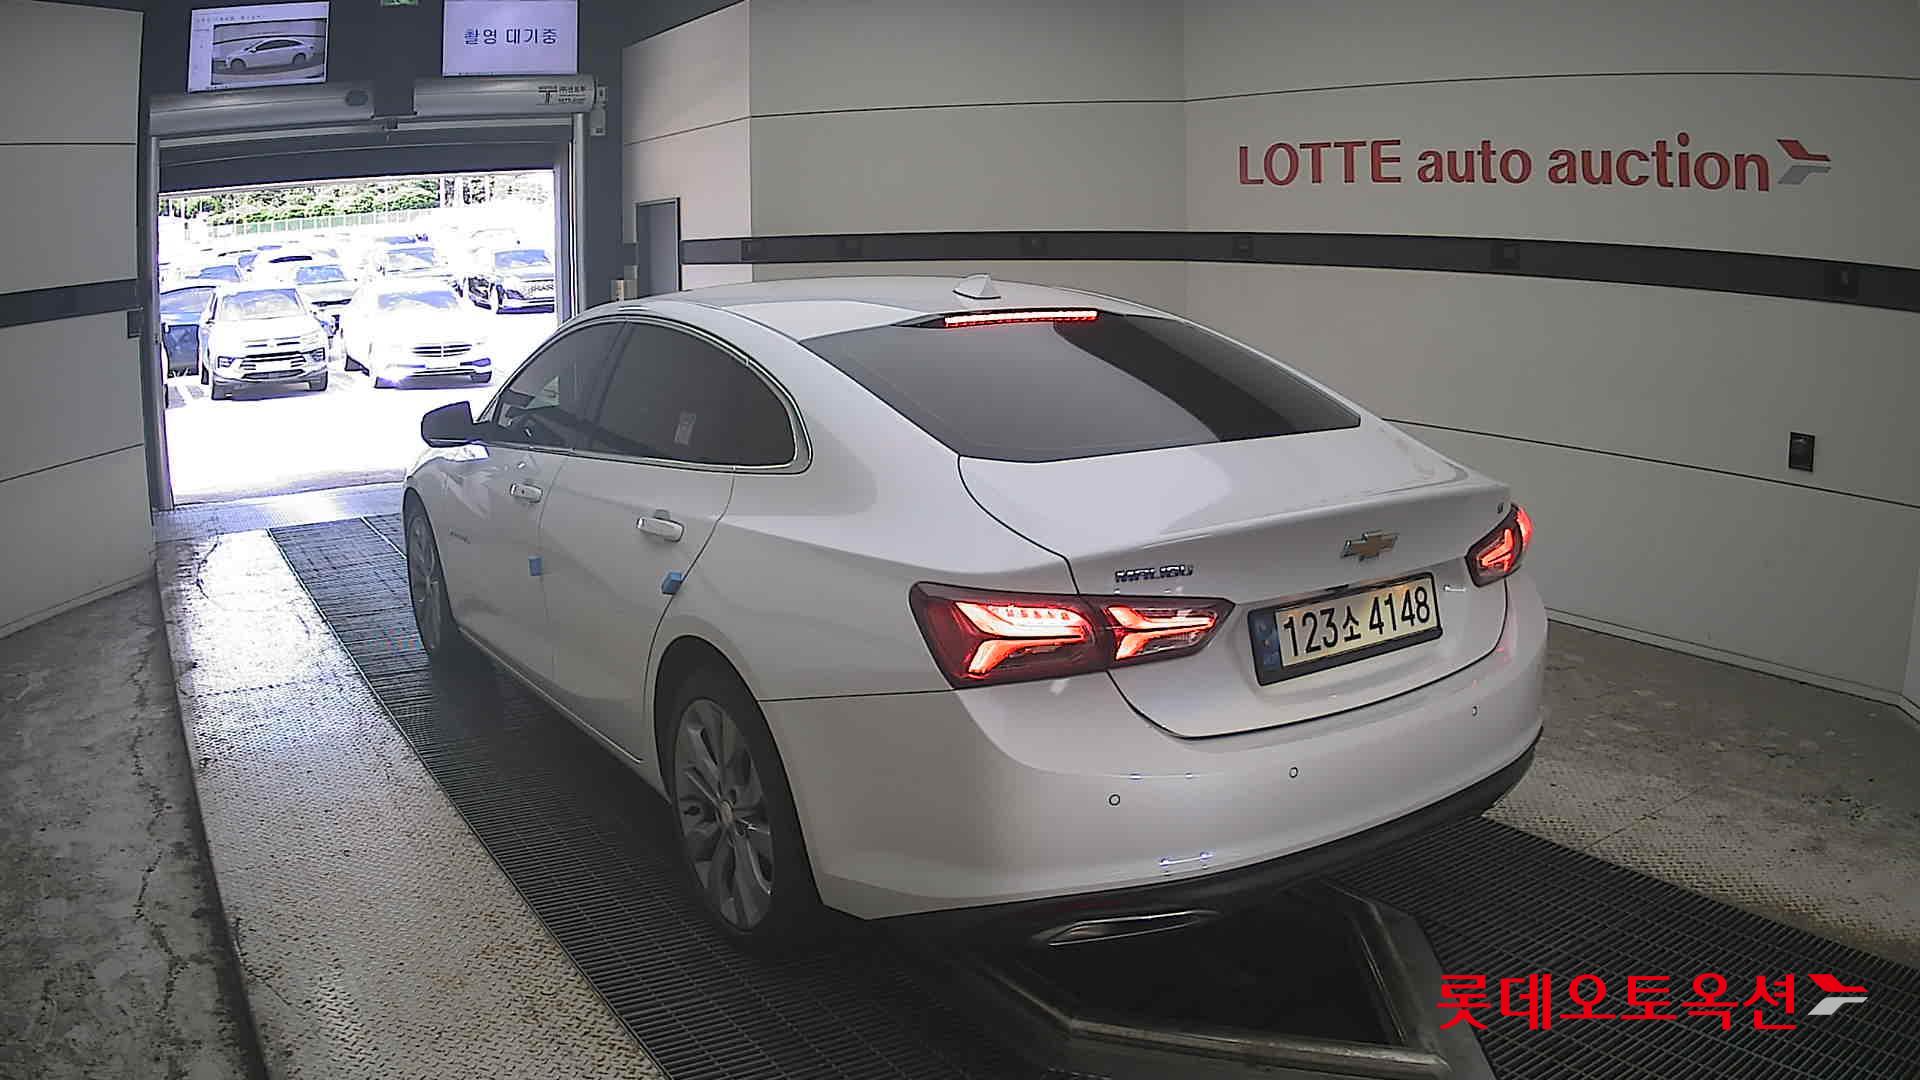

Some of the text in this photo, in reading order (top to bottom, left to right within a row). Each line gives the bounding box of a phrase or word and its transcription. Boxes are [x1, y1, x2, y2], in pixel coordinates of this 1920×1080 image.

[506, 28, 557, 45] 대기중
[1239, 132, 1770, 191] LOTTE auto auction
